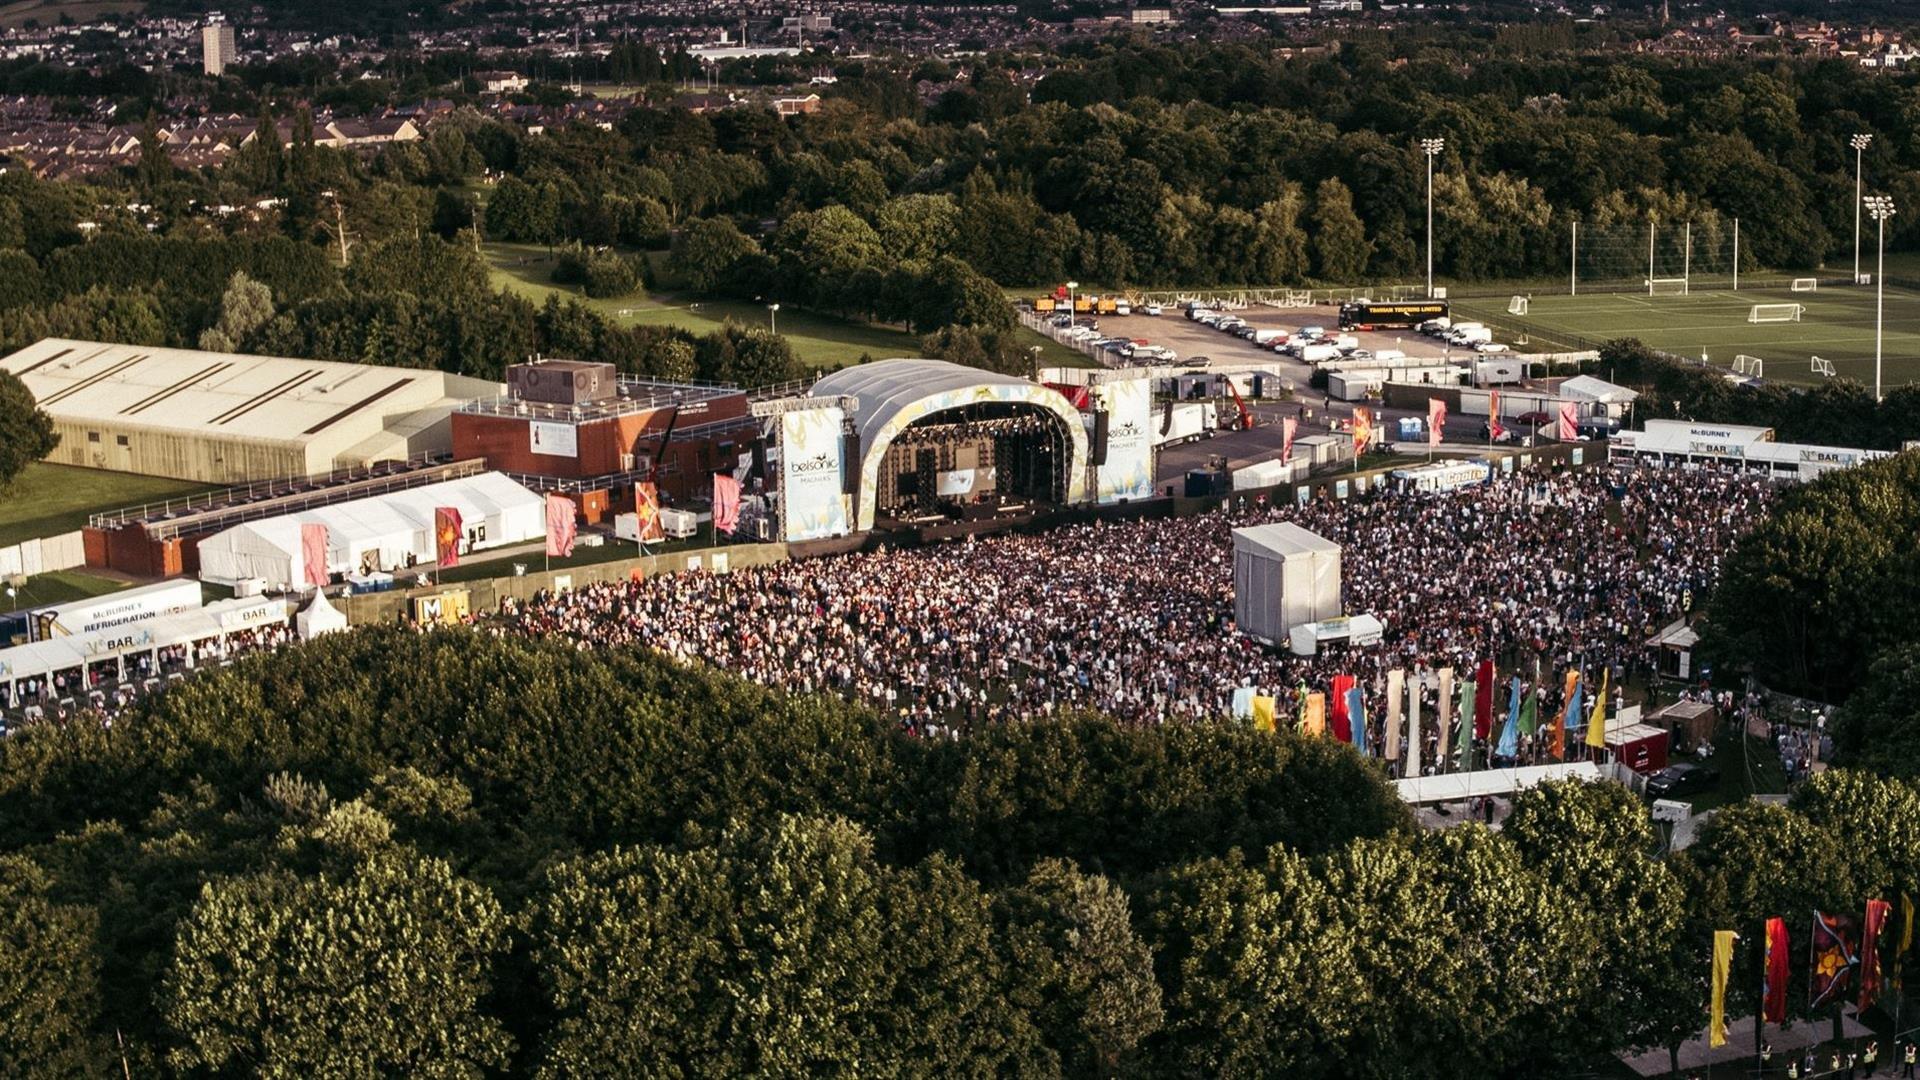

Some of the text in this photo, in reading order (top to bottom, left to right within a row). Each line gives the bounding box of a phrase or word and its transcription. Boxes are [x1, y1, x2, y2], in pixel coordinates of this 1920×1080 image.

[1106, 426, 1144, 438] elsonic
[1690, 429, 1731, 438] McBURNEY
[1706, 444, 1727, 453] BAR
[1817, 453, 1839, 462] BAR
[791, 459, 839, 473] belsonic
[92, 602, 143, 619] McBURNEY
[242, 608, 267, 621] BAR
[83, 611, 156, 633] REFRIGERATION
[107, 636, 133, 650] BAR
